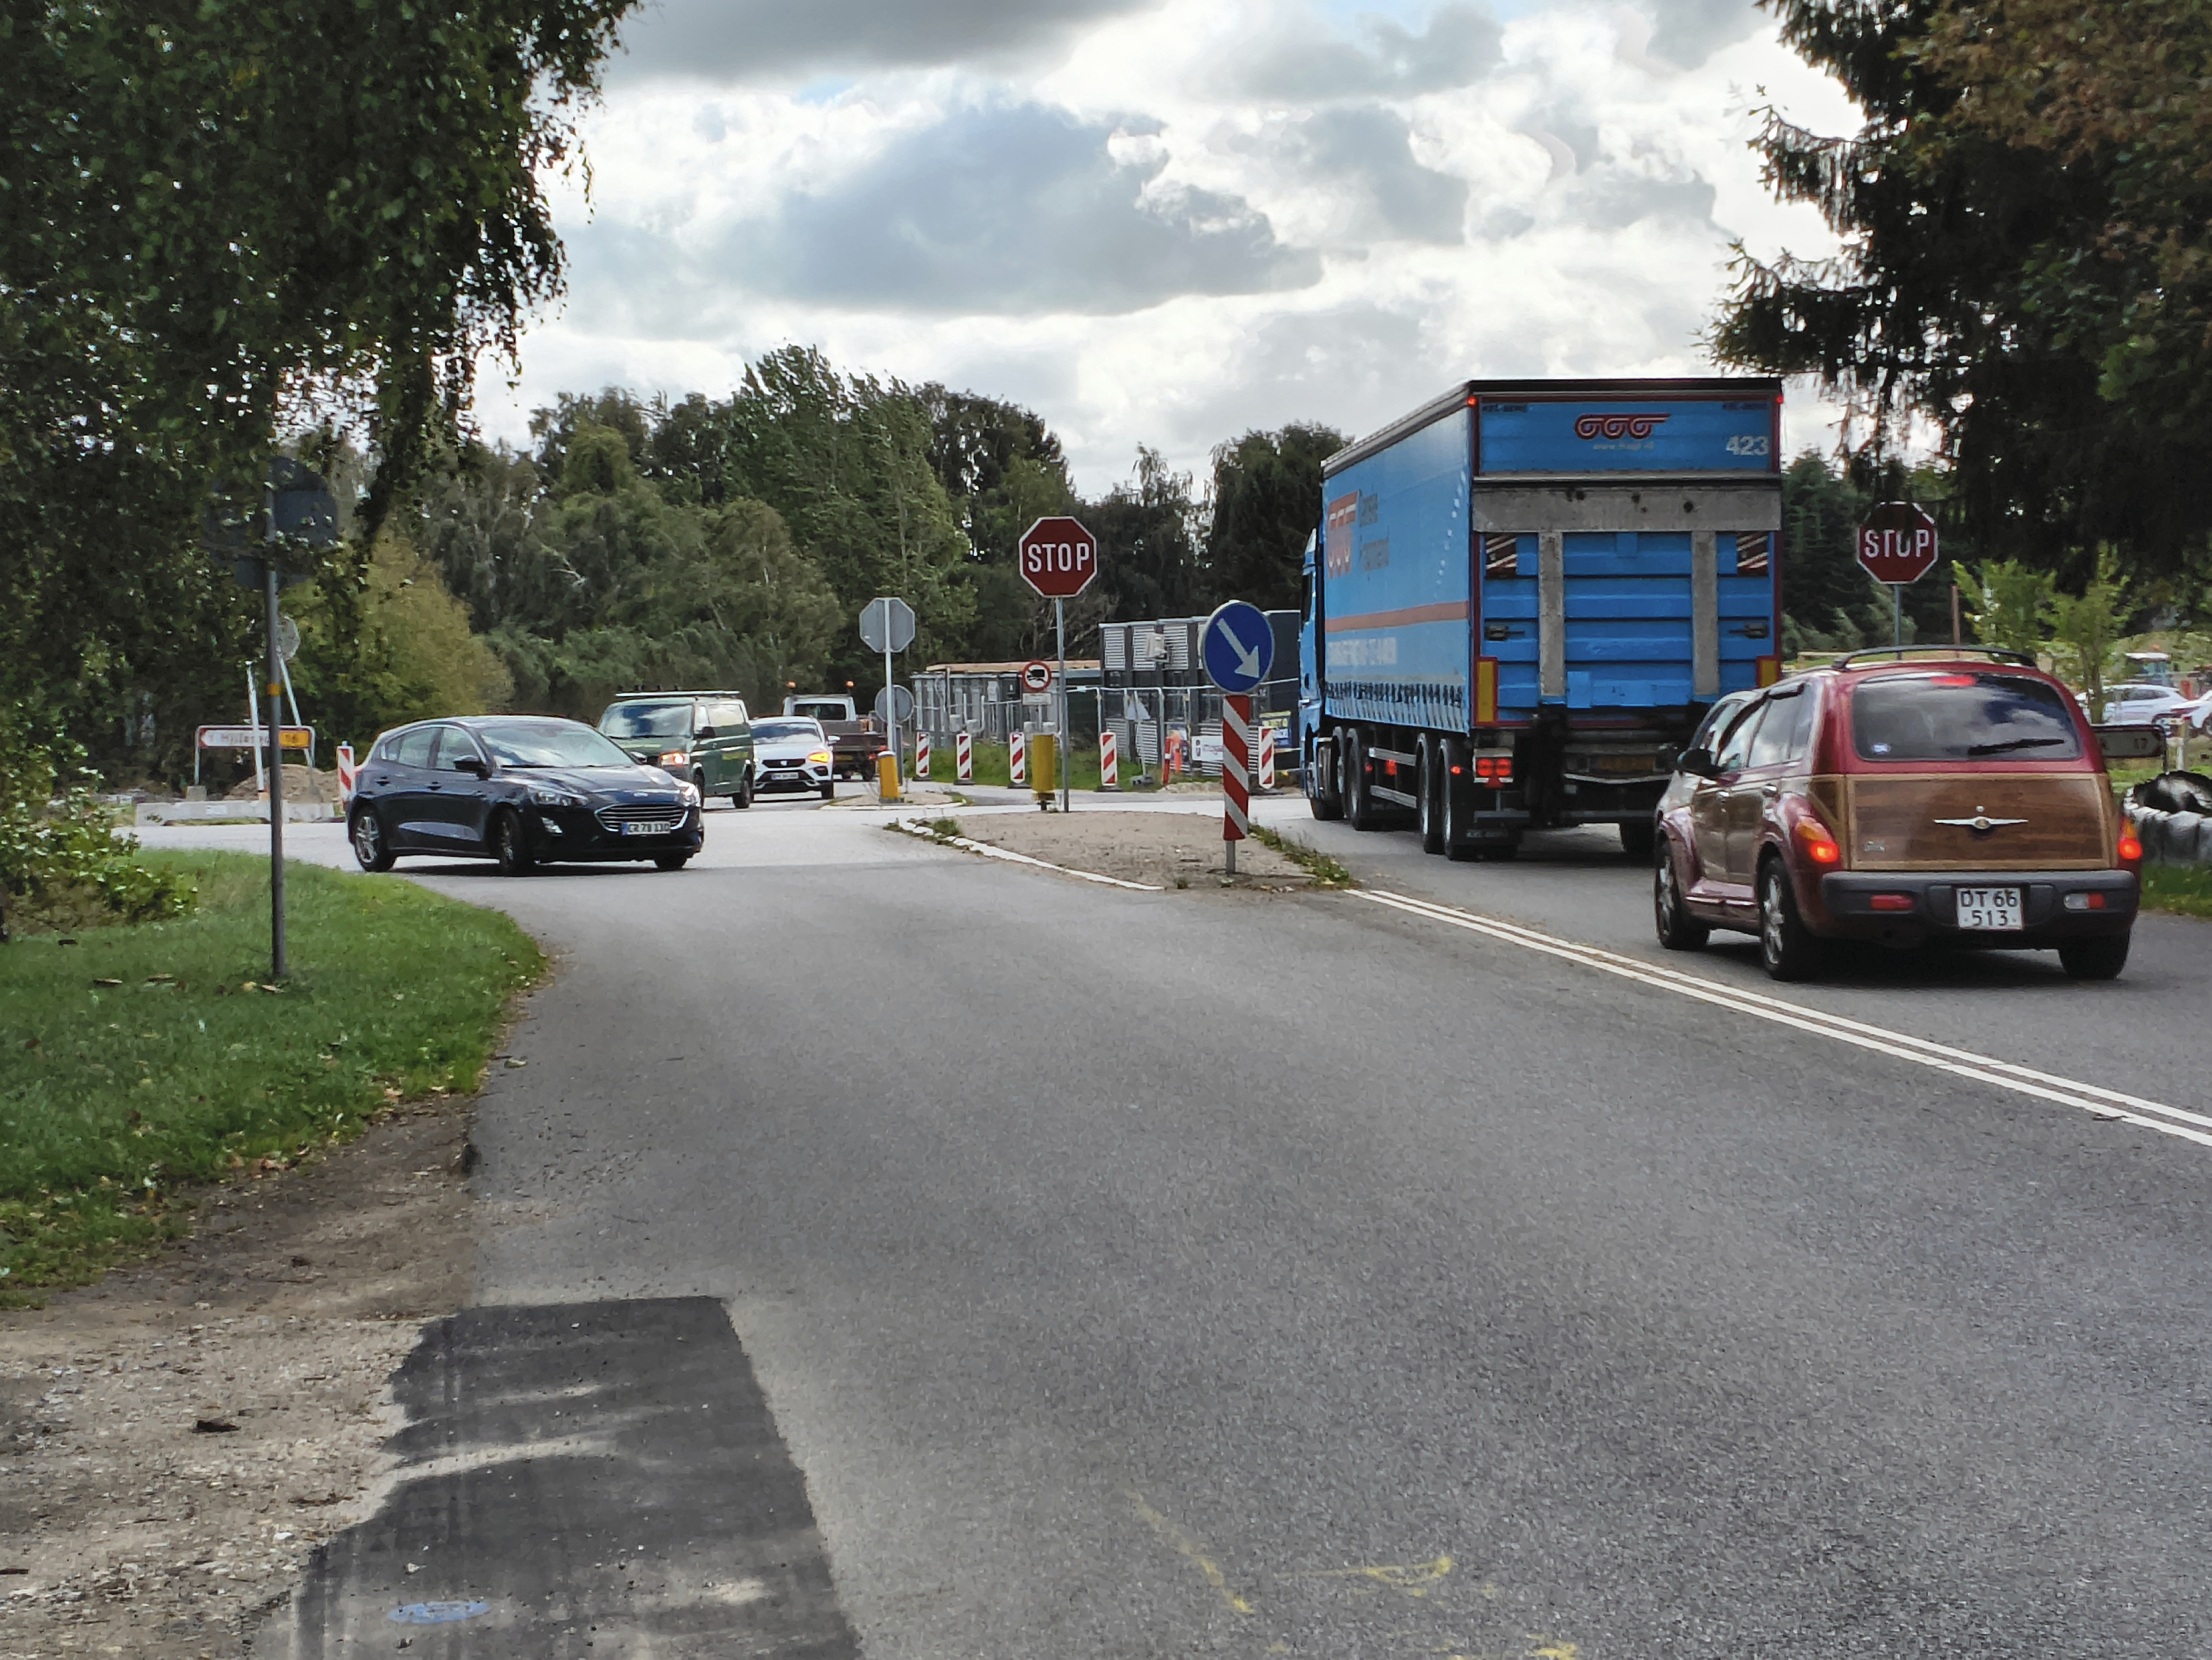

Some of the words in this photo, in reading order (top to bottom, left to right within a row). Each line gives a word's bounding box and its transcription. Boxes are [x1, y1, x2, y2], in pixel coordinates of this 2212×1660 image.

[1726, 435, 1768, 456] 423
[1865, 529, 1930, 558] STOP
[1028, 543, 1090, 572] STOP
[1960, 890, 1989, 907] DT
[1993, 890, 2018, 907] 66
[1972, 909, 2008, 926] 513
